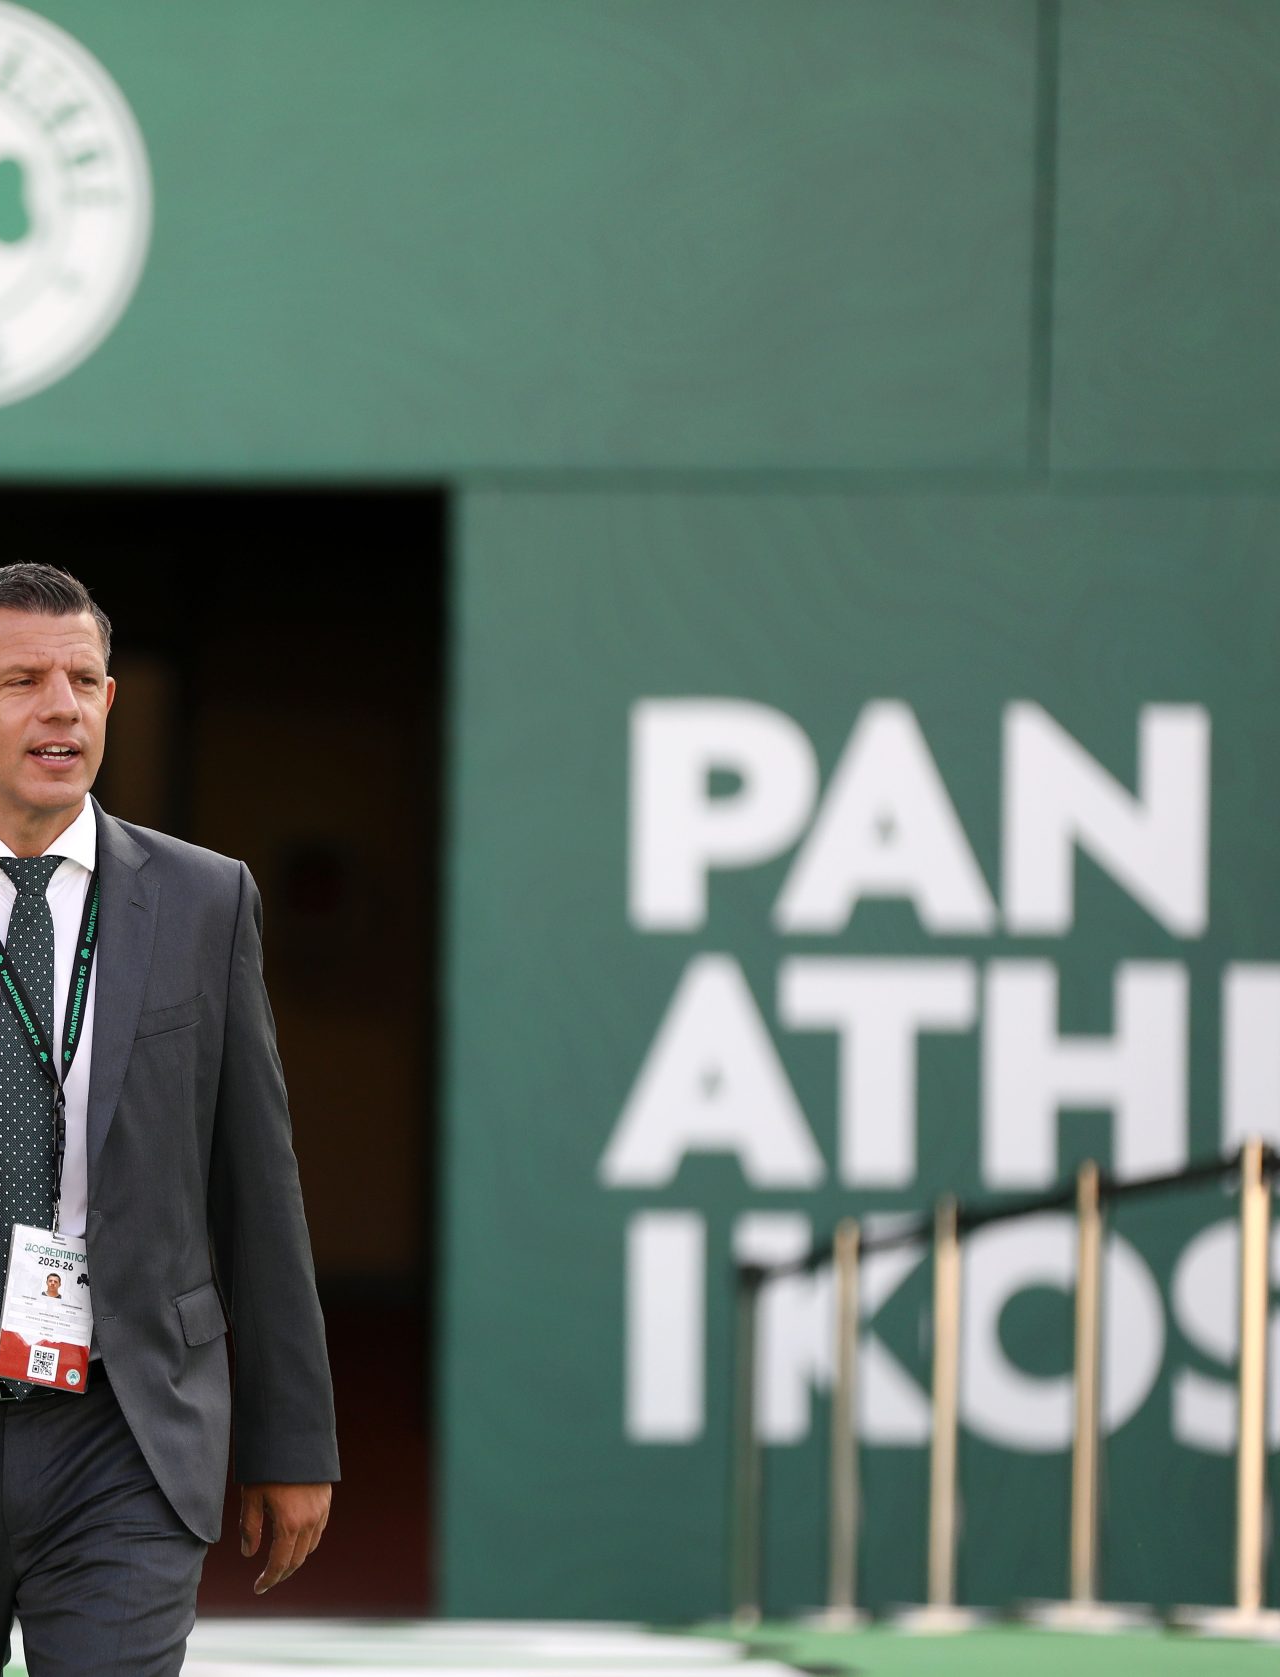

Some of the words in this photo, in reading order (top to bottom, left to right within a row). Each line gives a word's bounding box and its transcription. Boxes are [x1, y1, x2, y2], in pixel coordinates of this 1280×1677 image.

[627, 698, 1211, 939] PAN
[0, 970, 35, 1035] PANATHINAIKOS
[31, 1034, 40, 1046] FC
[68, 977, 86, 1044] PANATHINAIKOS
[79, 965, 87, 977] FC
[38, 1256, 74, 1271] 2025-26
[627, 1211, 1280, 1454] IKOS
